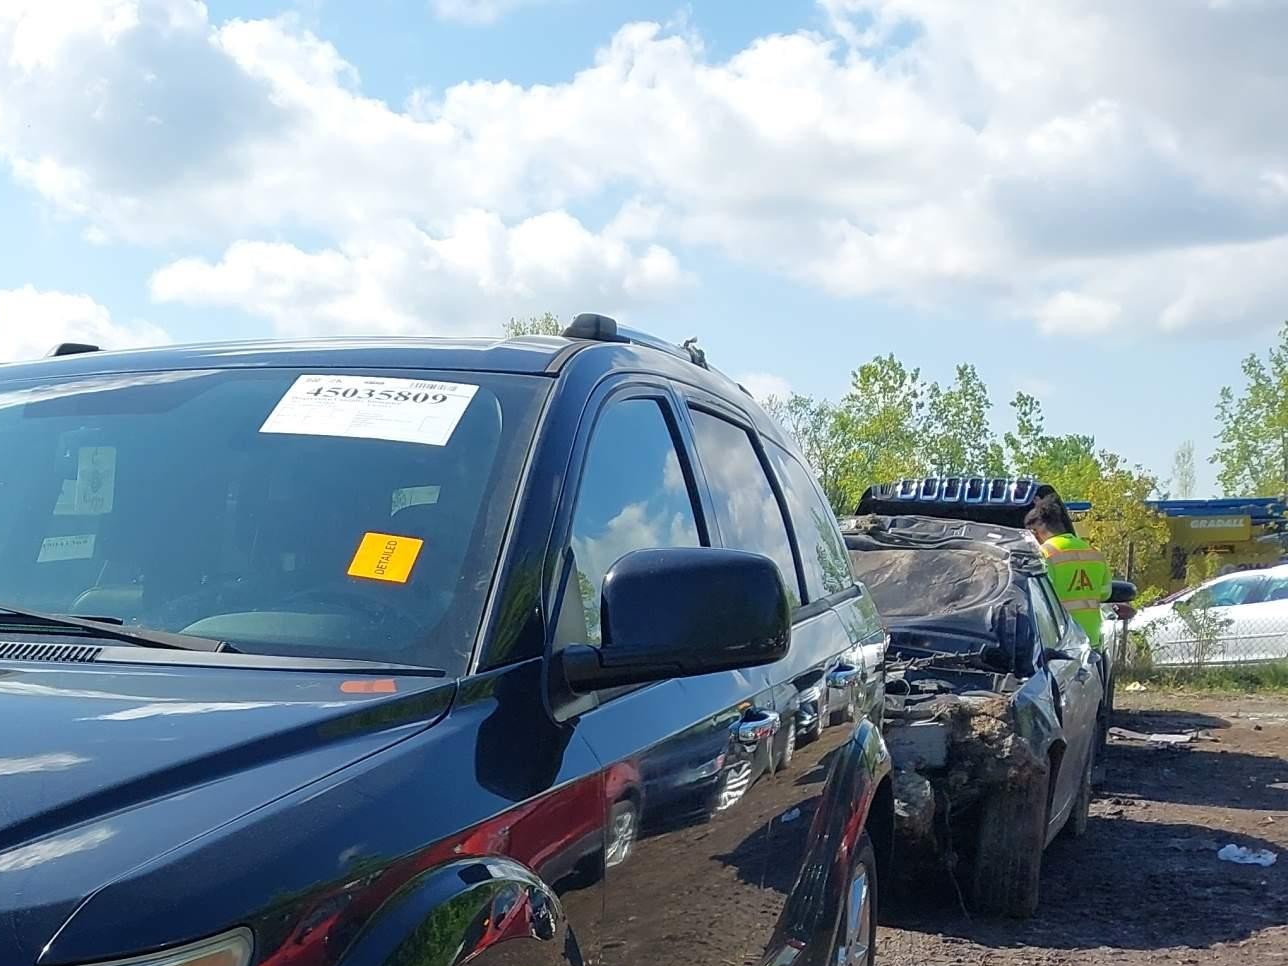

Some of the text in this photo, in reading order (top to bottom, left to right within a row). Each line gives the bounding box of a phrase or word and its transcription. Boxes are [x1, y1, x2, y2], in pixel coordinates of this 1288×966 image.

[306, 386, 448, 405] 45035809
[1190, 519, 1245, 529] GRADALL
[374, 540, 398, 575] DETAILED
